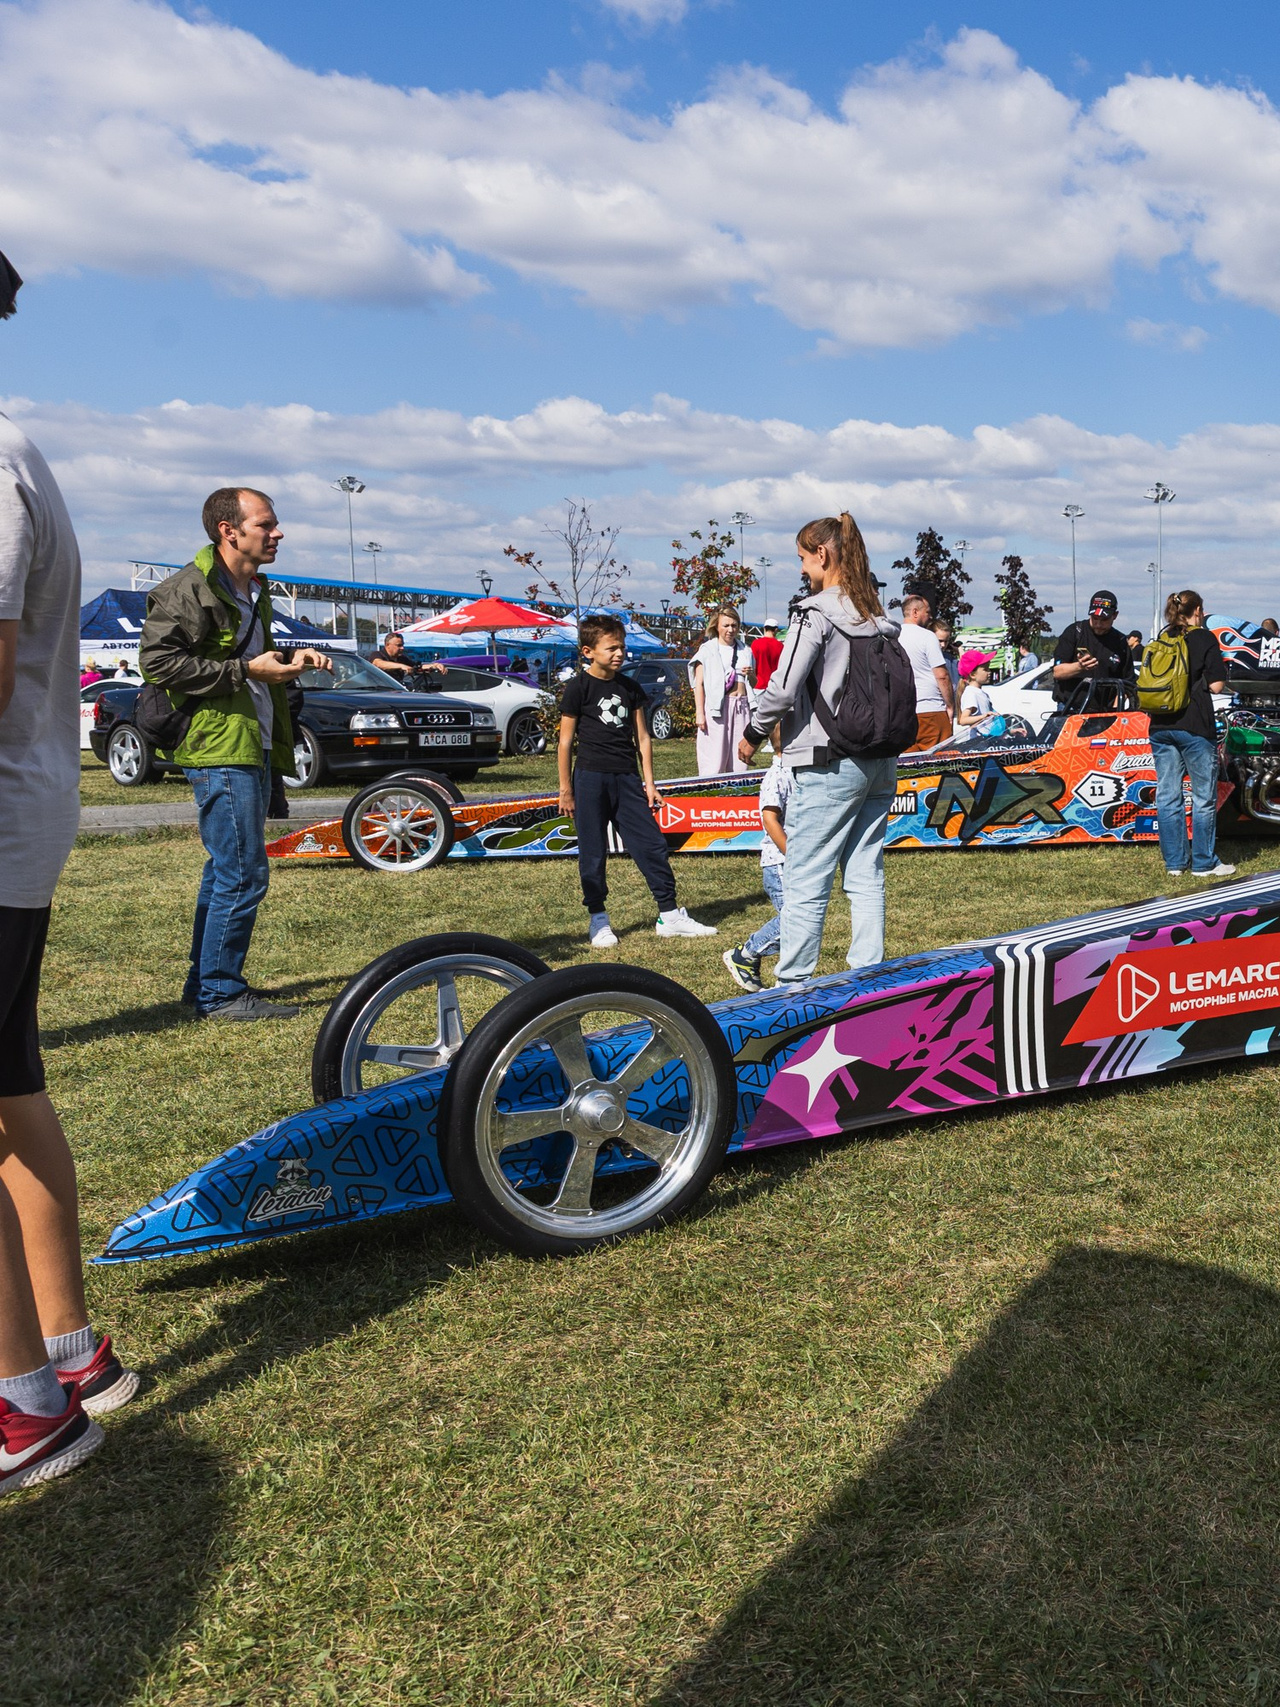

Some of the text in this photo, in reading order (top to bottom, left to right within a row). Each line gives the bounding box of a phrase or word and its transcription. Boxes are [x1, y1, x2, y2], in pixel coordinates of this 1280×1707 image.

[1090, 785, 1105, 797] 11
[691, 820, 761, 828] МОТОРНЫЕ МАСЛА
[1169, 961, 1280, 995] LEMARC
[1170, 986, 1279, 1013] МОТОРНЫЕ МАСЛА
